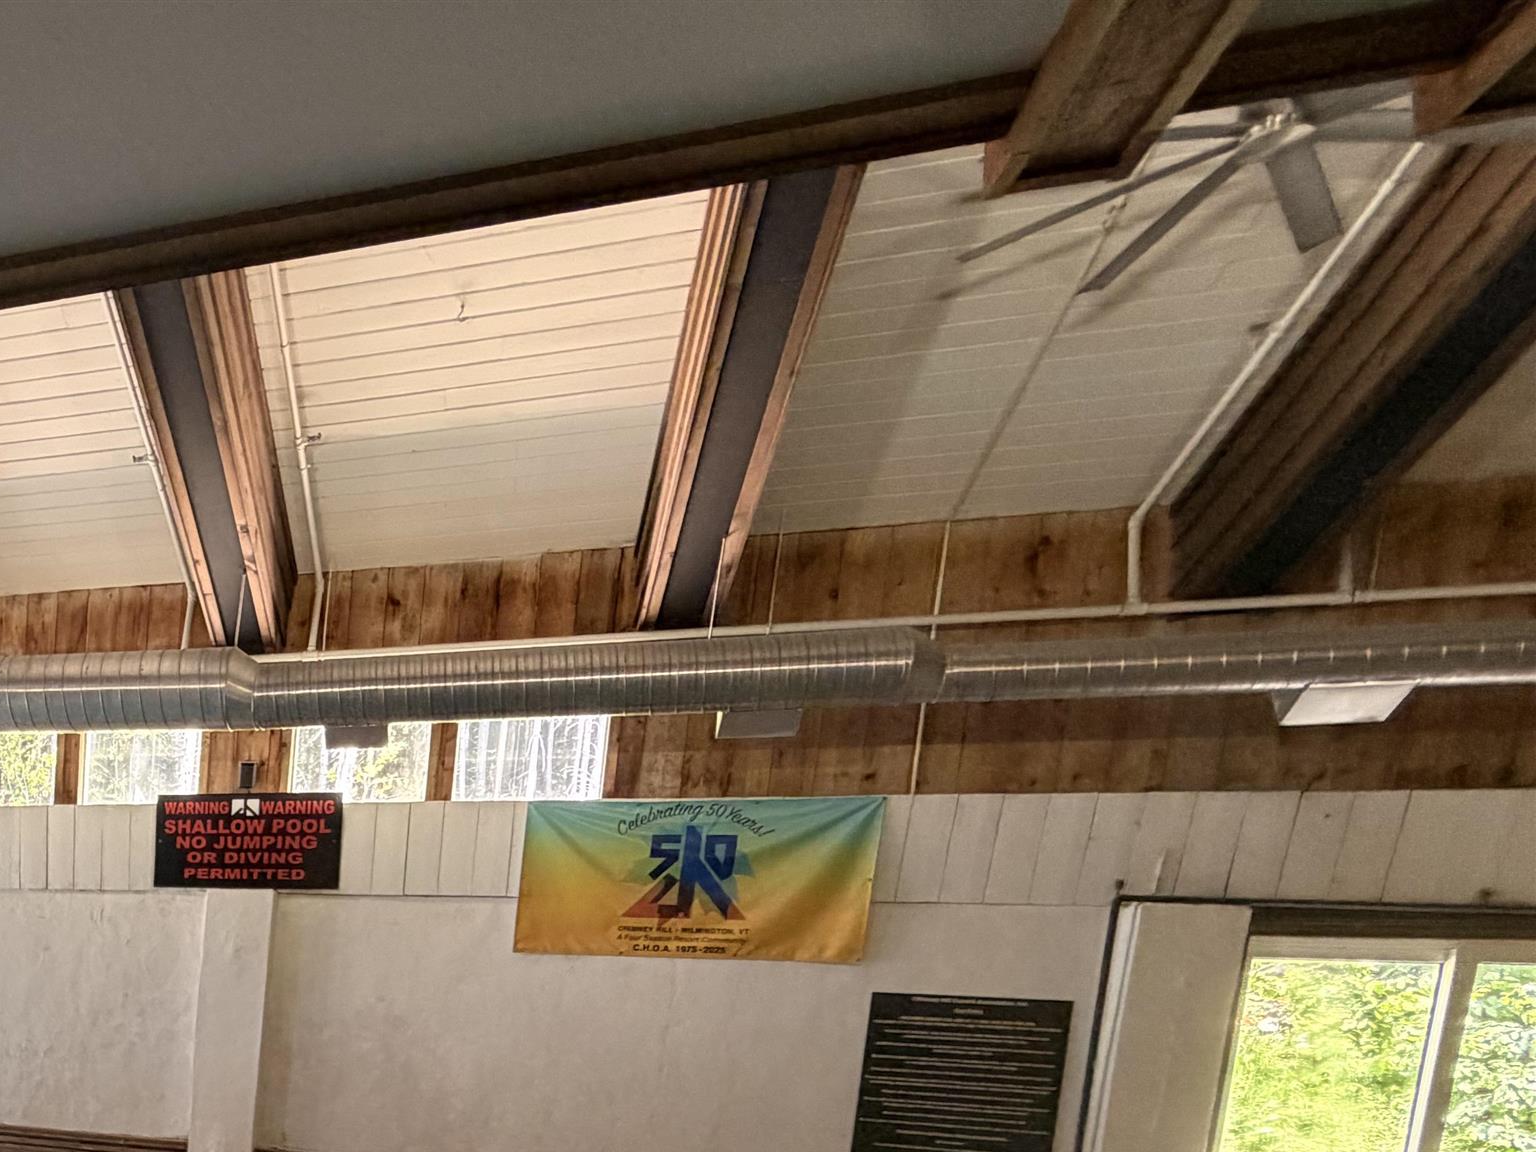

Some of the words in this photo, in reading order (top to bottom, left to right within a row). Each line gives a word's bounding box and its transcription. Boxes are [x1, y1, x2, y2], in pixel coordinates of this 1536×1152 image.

[164, 801, 229, 815] WARNING
[261, 800, 335, 815] WARNING
[164, 819, 265, 834] SHALLOW
[272, 818, 332, 834] POOL
[617, 801, 705, 836] Celebrating
[706, 803, 728, 818] 50
[726, 806, 776, 838] Years!
[175, 835, 207, 849] NO
[213, 835, 318, 849] JUMPING
[186, 851, 217, 864] OR
[224, 851, 304, 865] DIVING
[183, 867, 305, 880] PERMITTED
